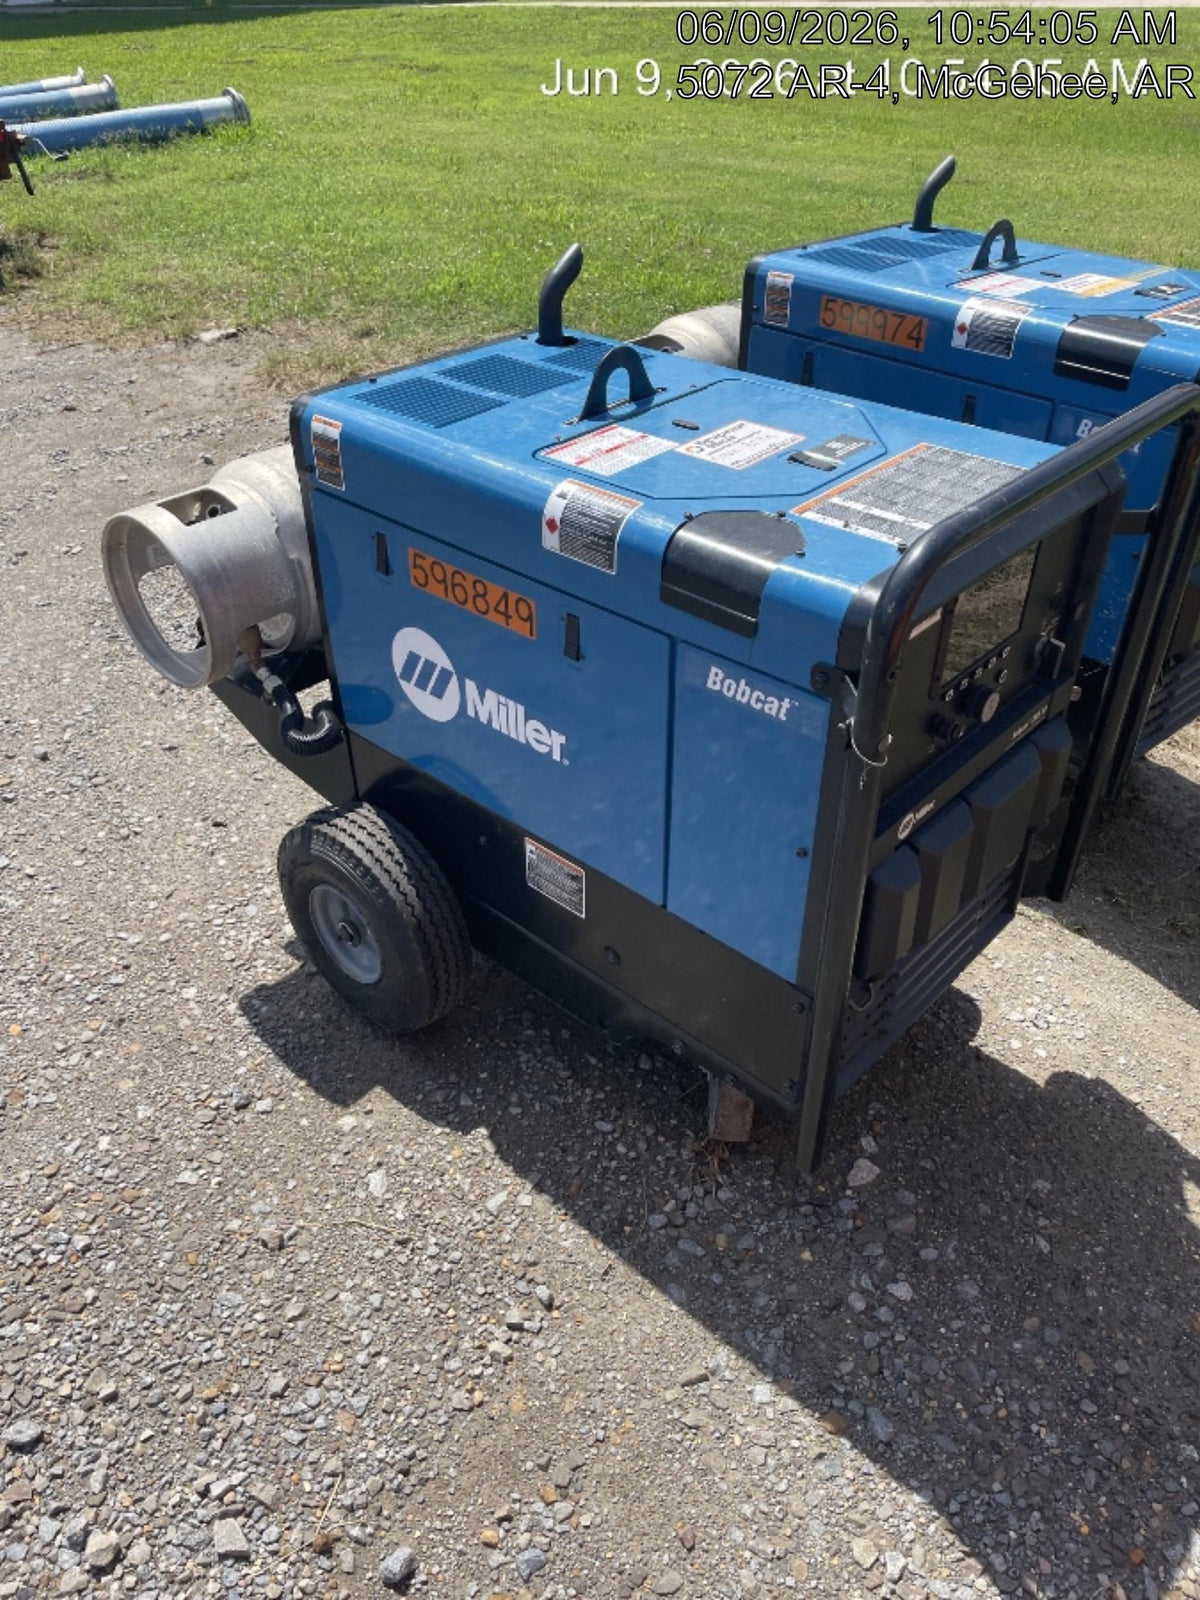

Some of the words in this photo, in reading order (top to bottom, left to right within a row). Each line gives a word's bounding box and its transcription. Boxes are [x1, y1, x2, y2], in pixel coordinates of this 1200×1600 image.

[821, 297, 925, 350] 599974
[411, 551, 536, 638] 596849
[464, 677, 567, 763] Miller
[706, 665, 791, 721] Bobcat
